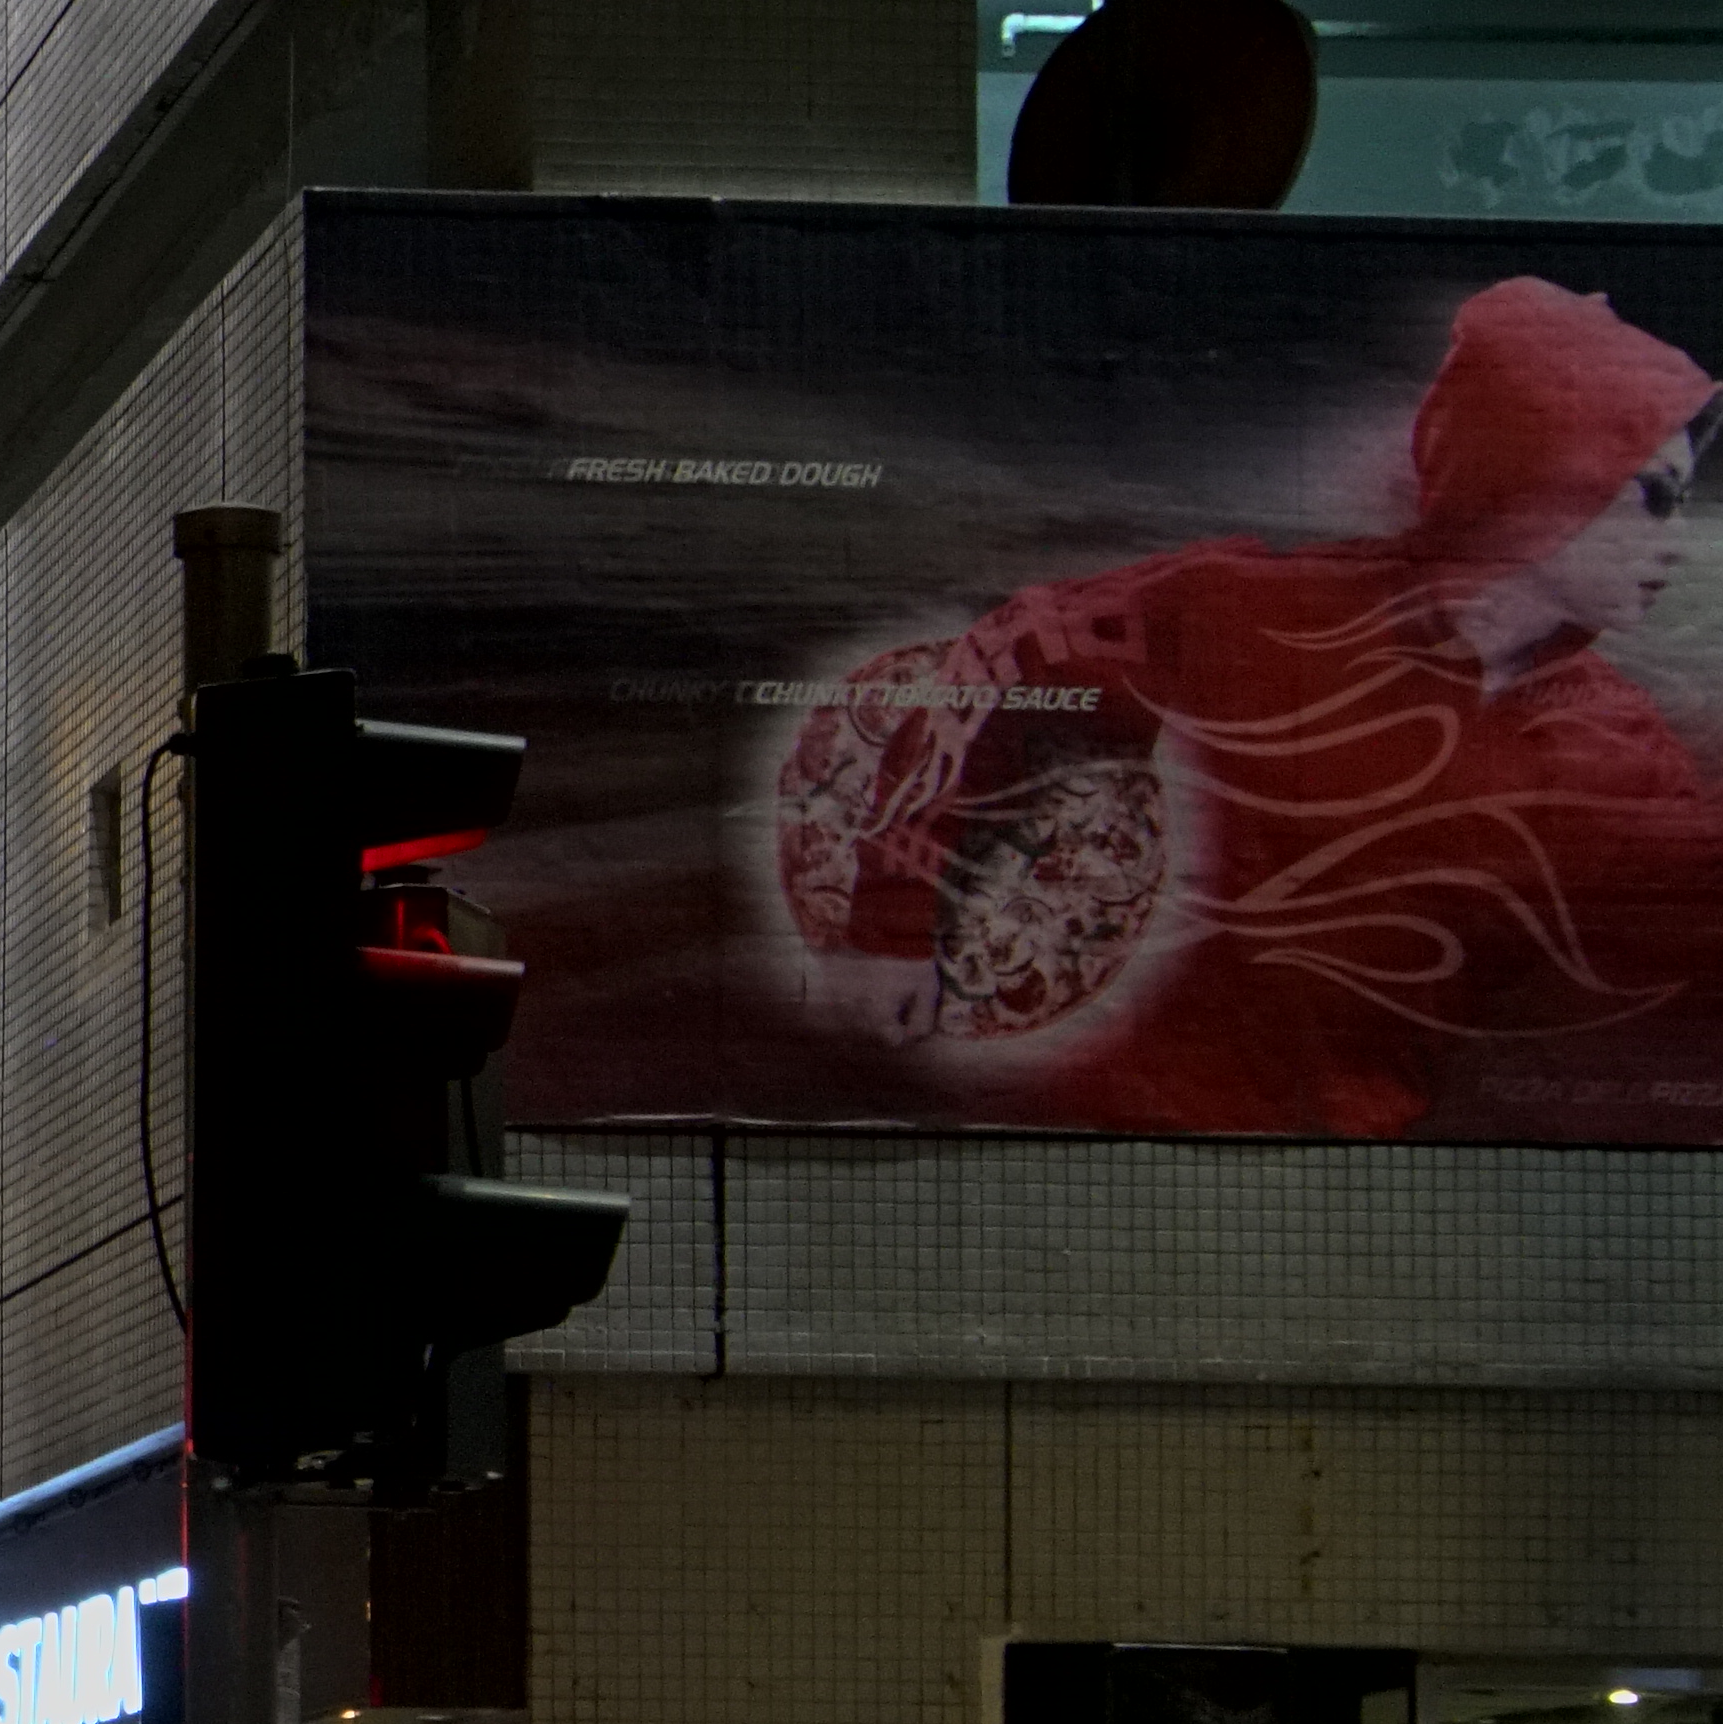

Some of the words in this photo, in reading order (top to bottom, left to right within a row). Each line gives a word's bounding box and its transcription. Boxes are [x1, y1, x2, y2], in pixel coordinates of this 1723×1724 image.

[567, 457, 666, 483] FRESH
[673, 459, 771, 485] BAKED
[779, 461, 883, 488] DOUGH
[755, 681, 867, 709] CHUNKY
[872, 683, 999, 711] TOMATO
[1002, 686, 1102, 712] SAUCE
